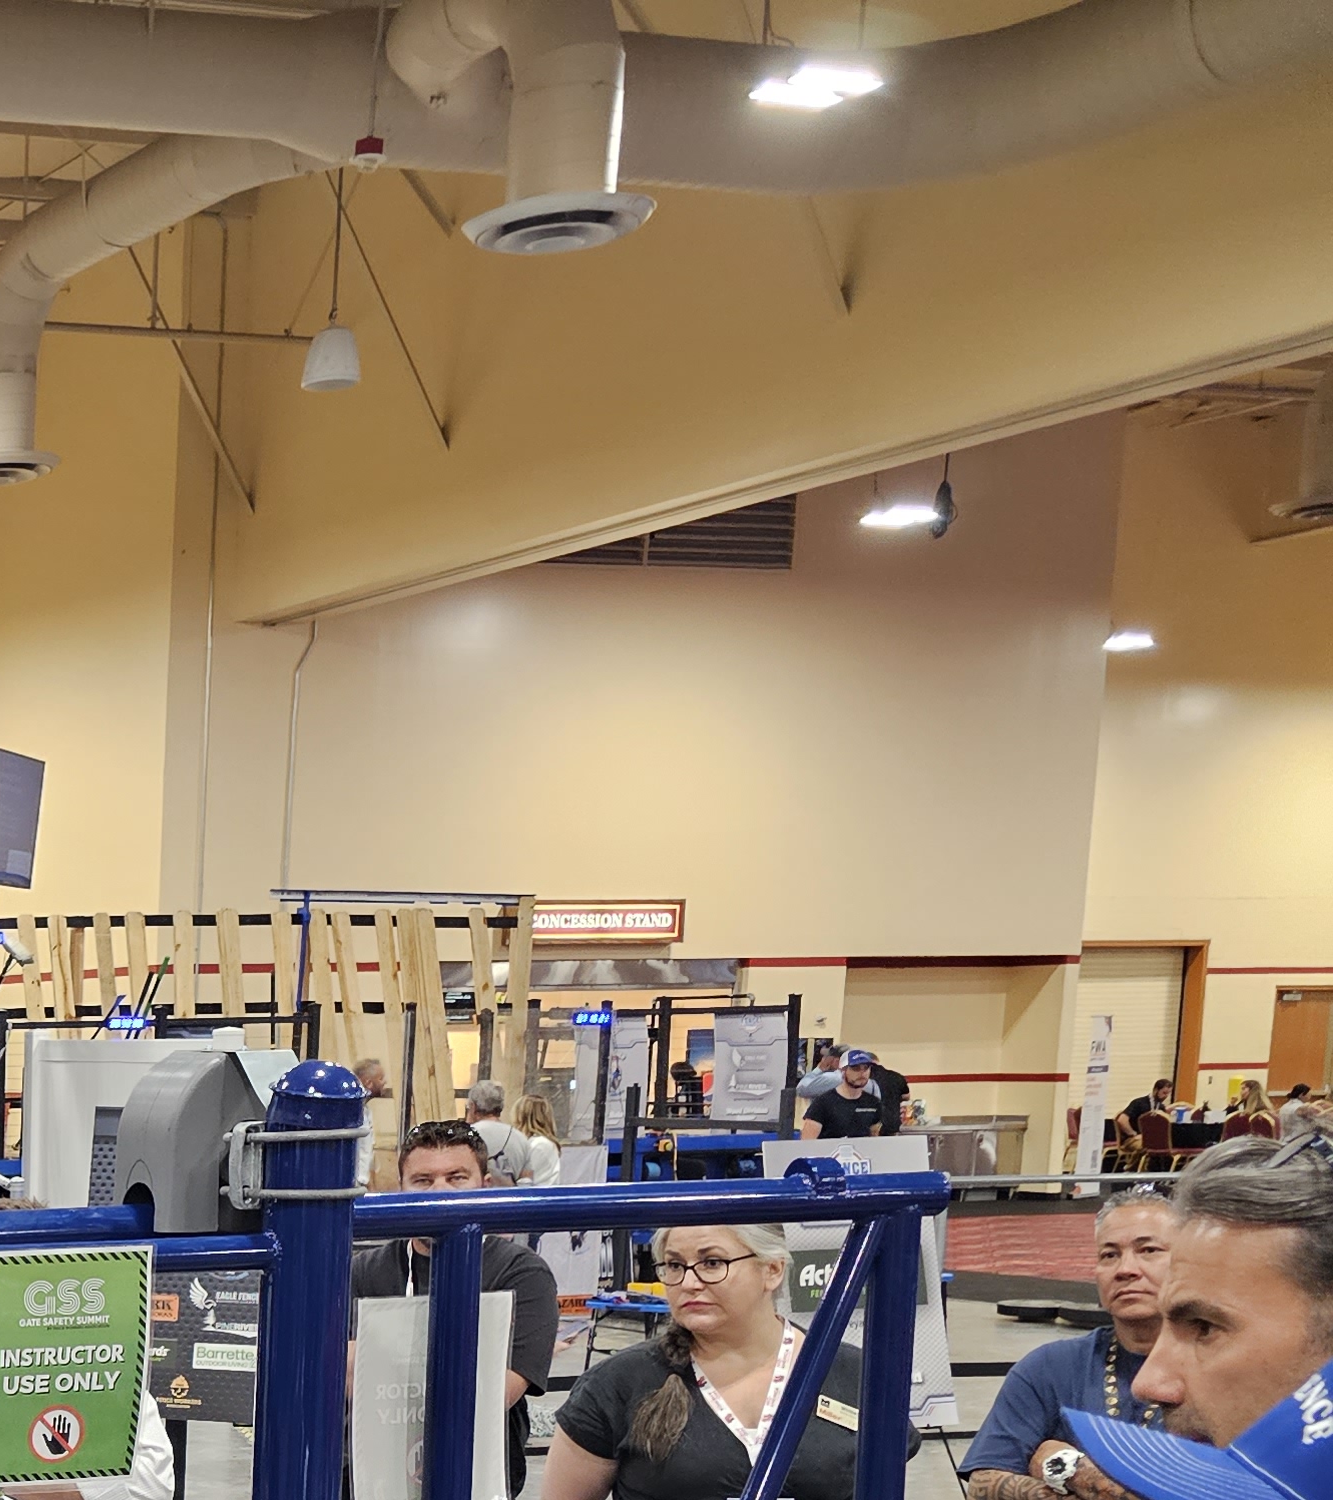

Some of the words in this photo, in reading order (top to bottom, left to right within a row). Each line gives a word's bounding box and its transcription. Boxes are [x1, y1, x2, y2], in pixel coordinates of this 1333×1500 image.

[625, 913, 673, 928] STAND
[24, 1278, 105, 1317] GSS
[19, 1318, 41, 1327] GATE
[43, 1317, 75, 1326] SAFETY
[77, 1315, 110, 1325] SUMMIT
[0, 1344, 125, 1368] INSTRUCTOR
[196, 1347, 254, 1361] Barrette
[2, 1375, 50, 1395] USE
[55, 1371, 121, 1392] ONLY
